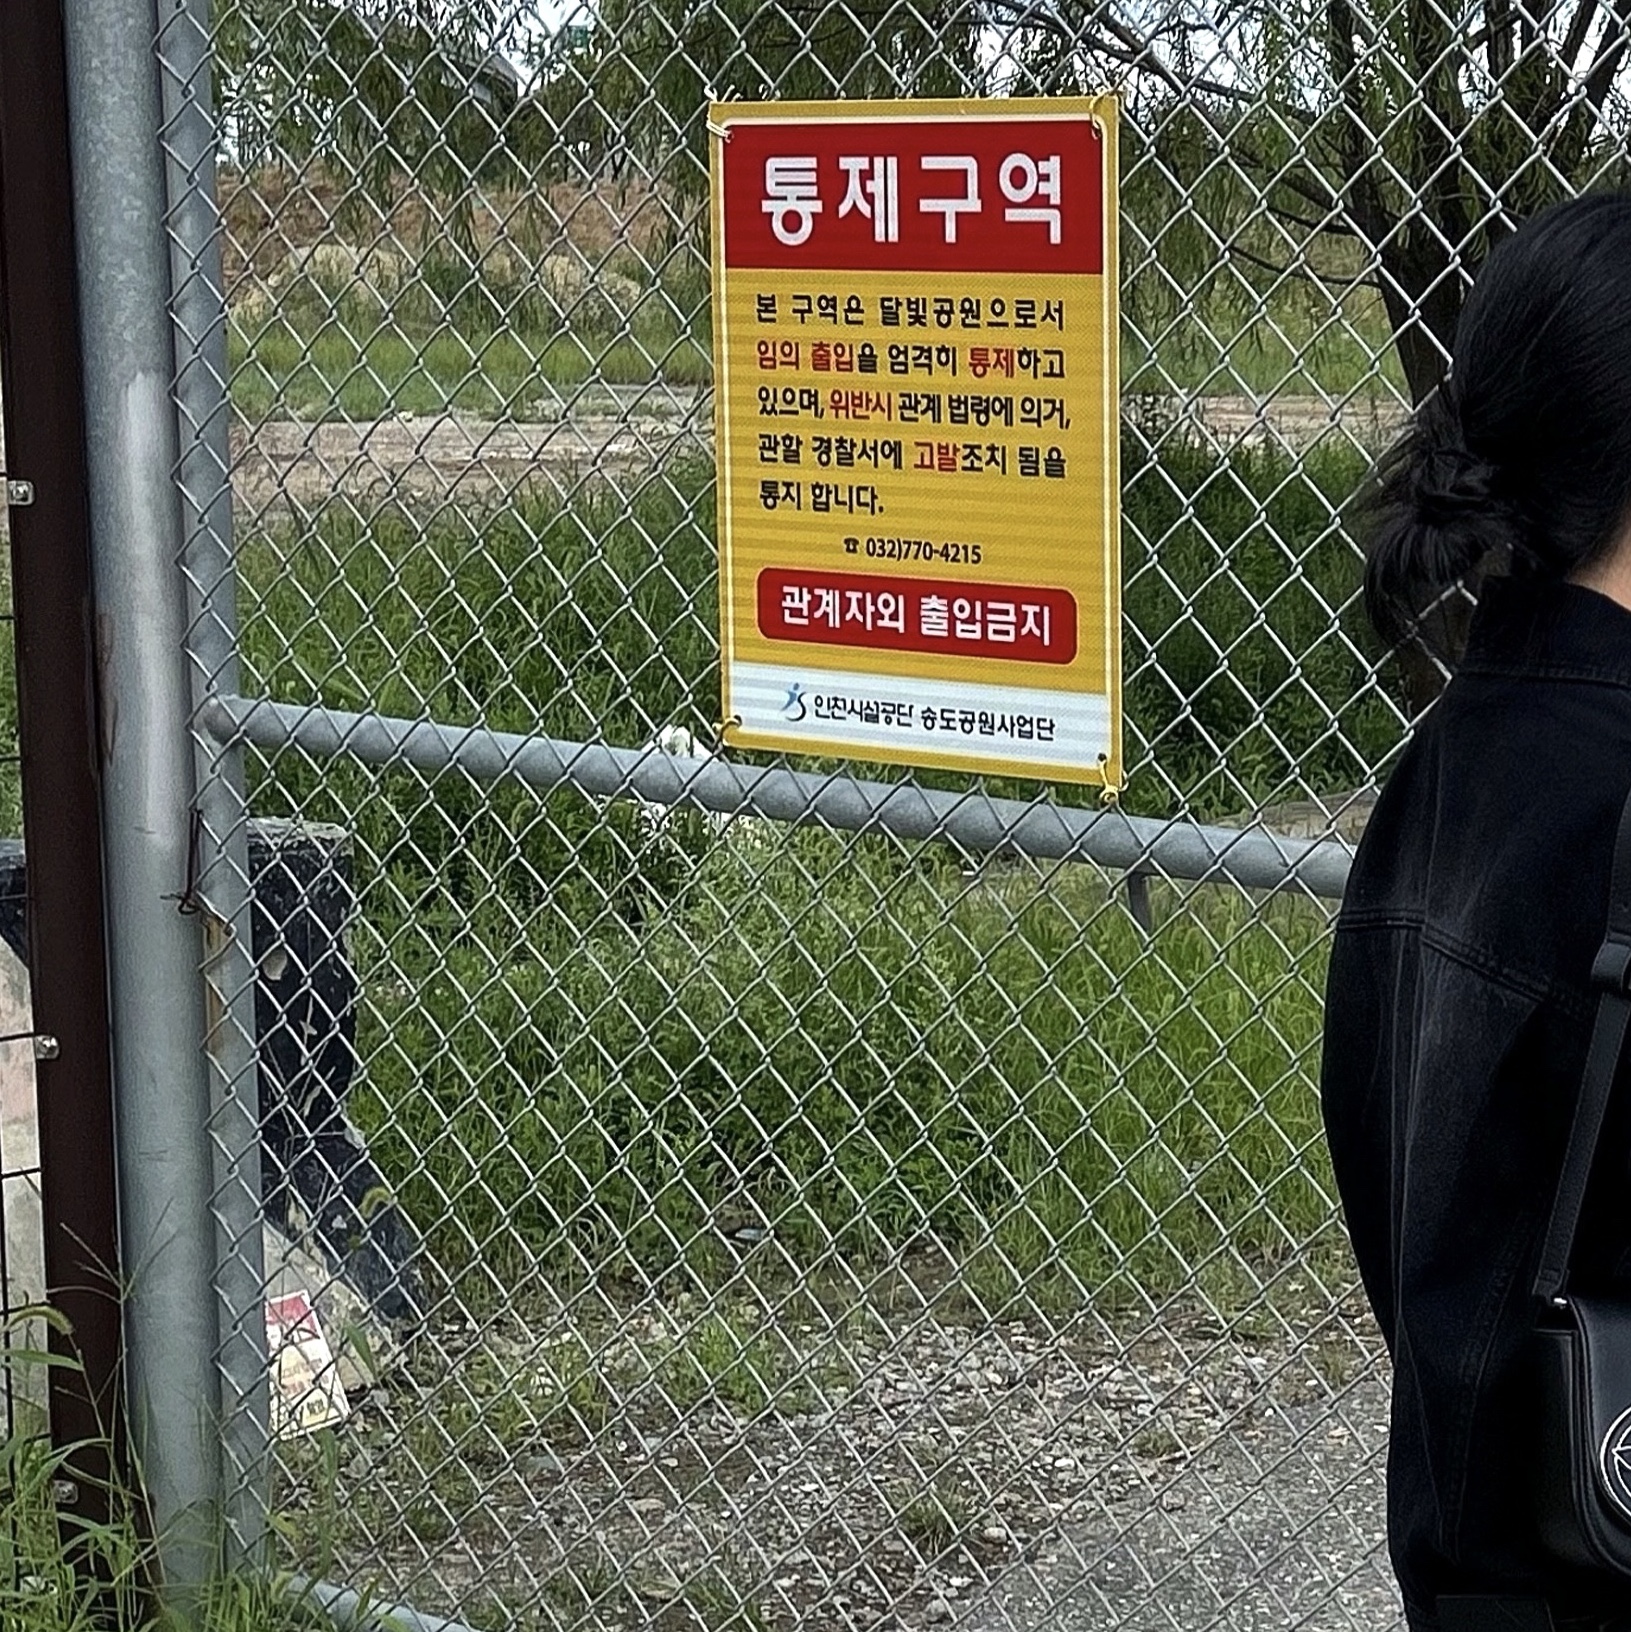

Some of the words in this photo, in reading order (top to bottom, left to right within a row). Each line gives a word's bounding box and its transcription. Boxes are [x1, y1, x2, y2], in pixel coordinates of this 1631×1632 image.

[761, 152, 1062, 246] 통제구역
[756, 293, 777, 323] 본
[791, 294, 865, 325] 구역은
[879, 296, 1064, 331] 달빛공원으로서
[757, 340, 800, 370] 임의
[811, 341, 878, 373] 출입을
[887, 344, 957, 377] 엄격히
[968, 346, 1065, 379] 통제하고
[757, 386, 825, 419] 있으며,
[829, 388, 892, 421] 위반시
[898, 392, 942, 424] 관계
[947, 394, 1014, 427] 법령에
[1019, 396, 1071, 430] 의거,
[758, 433, 803, 464] 관할
[811, 436, 903, 469] 경찰서에
[913, 441, 1007, 476] 고발조치
[1018, 446, 1067, 479] 됨을
[759, 480, 802, 511] 통지
[810, 481, 884, 516] 합니다.
[865, 537, 982, 564] 032)770-4215
[781, 585, 906, 633] 관계자외
[920, 595, 1051, 646] 출입금지
[813, 694, 915, 728] 인천시설공단
[920, 706, 1056, 742] 송도공원사업단
